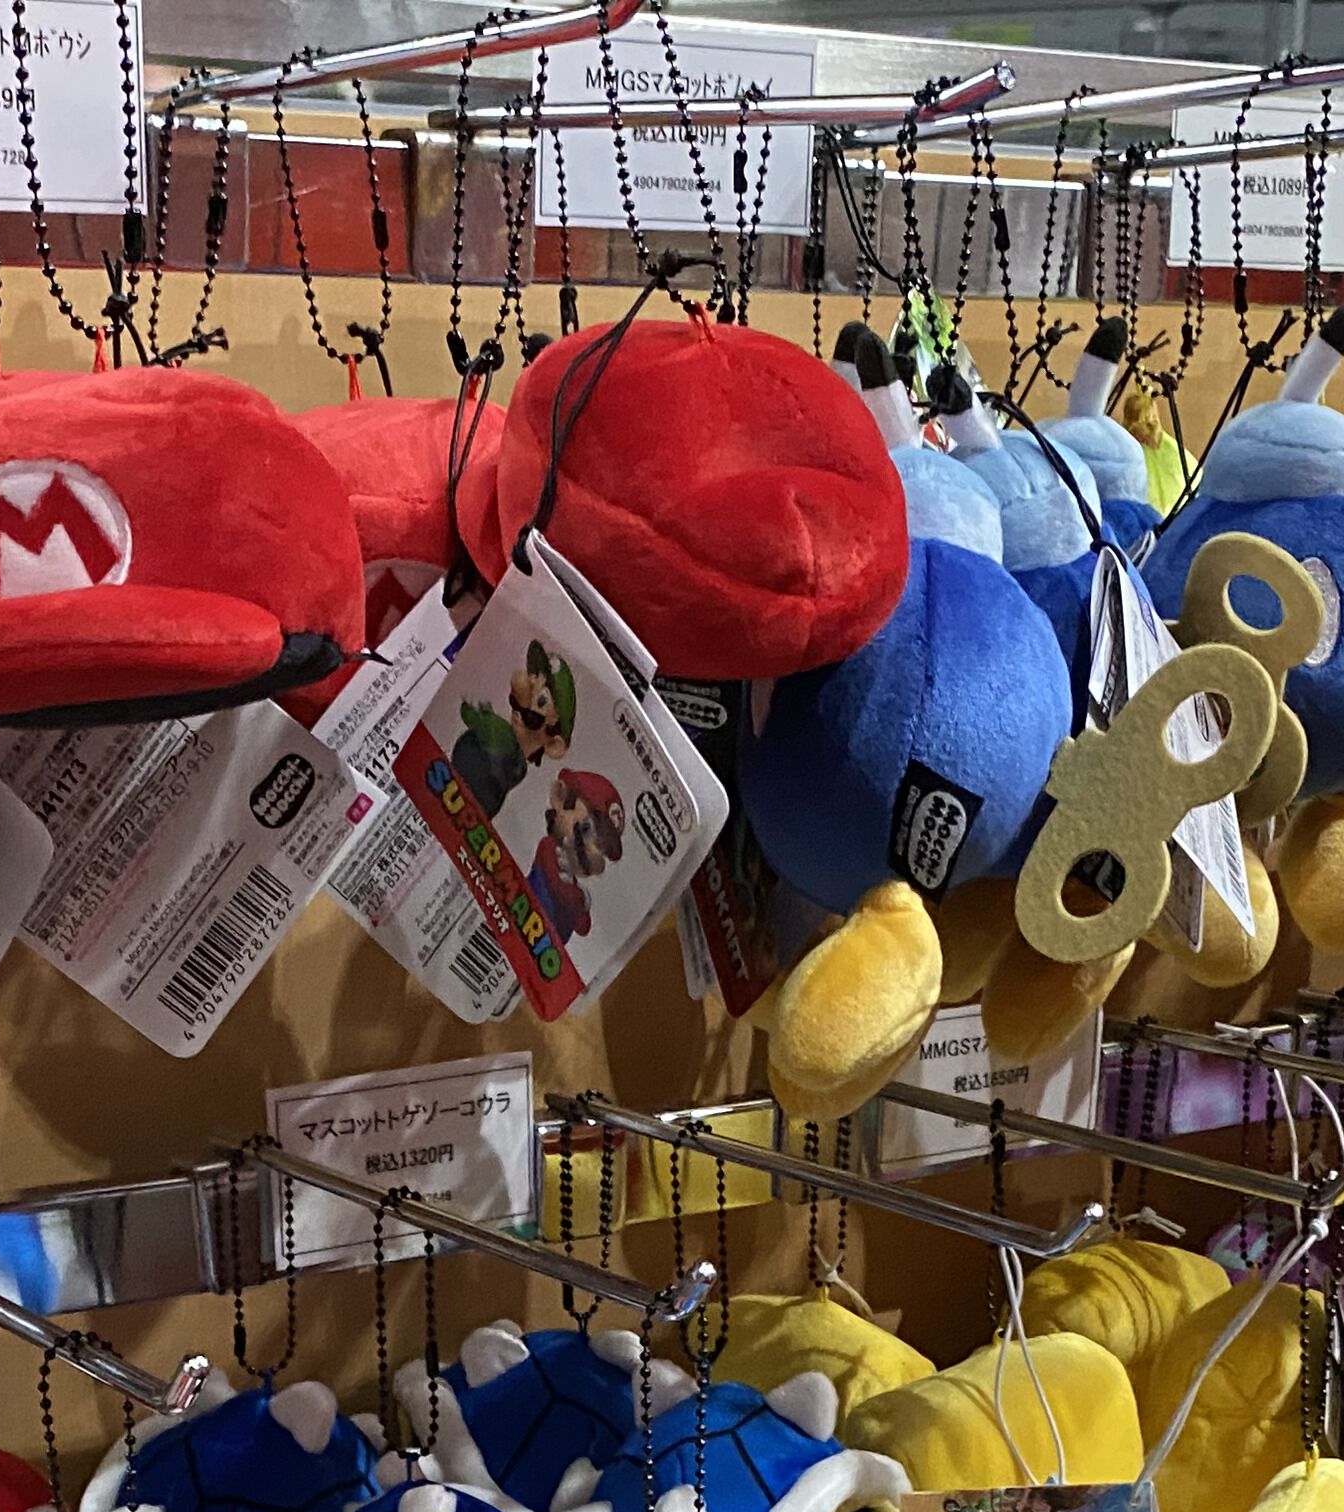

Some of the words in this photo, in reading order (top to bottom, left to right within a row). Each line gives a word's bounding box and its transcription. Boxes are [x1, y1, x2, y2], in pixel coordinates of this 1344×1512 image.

[249, 753, 307, 818] Mocchi-
[261, 763, 319, 828] Mocchi-
[908, 794, 948, 877] Mocchi-
[919, 802, 963, 888] Mocchi-
[181, 1028, 196, 1042] 4
[192, 958, 247, 1025] 904790
[239, 893, 297, 962] 287282
[299, 1091, 512, 1142] マスコットトゲゾーコウラ
[365, 1143, 454, 1176] 税込1320円
